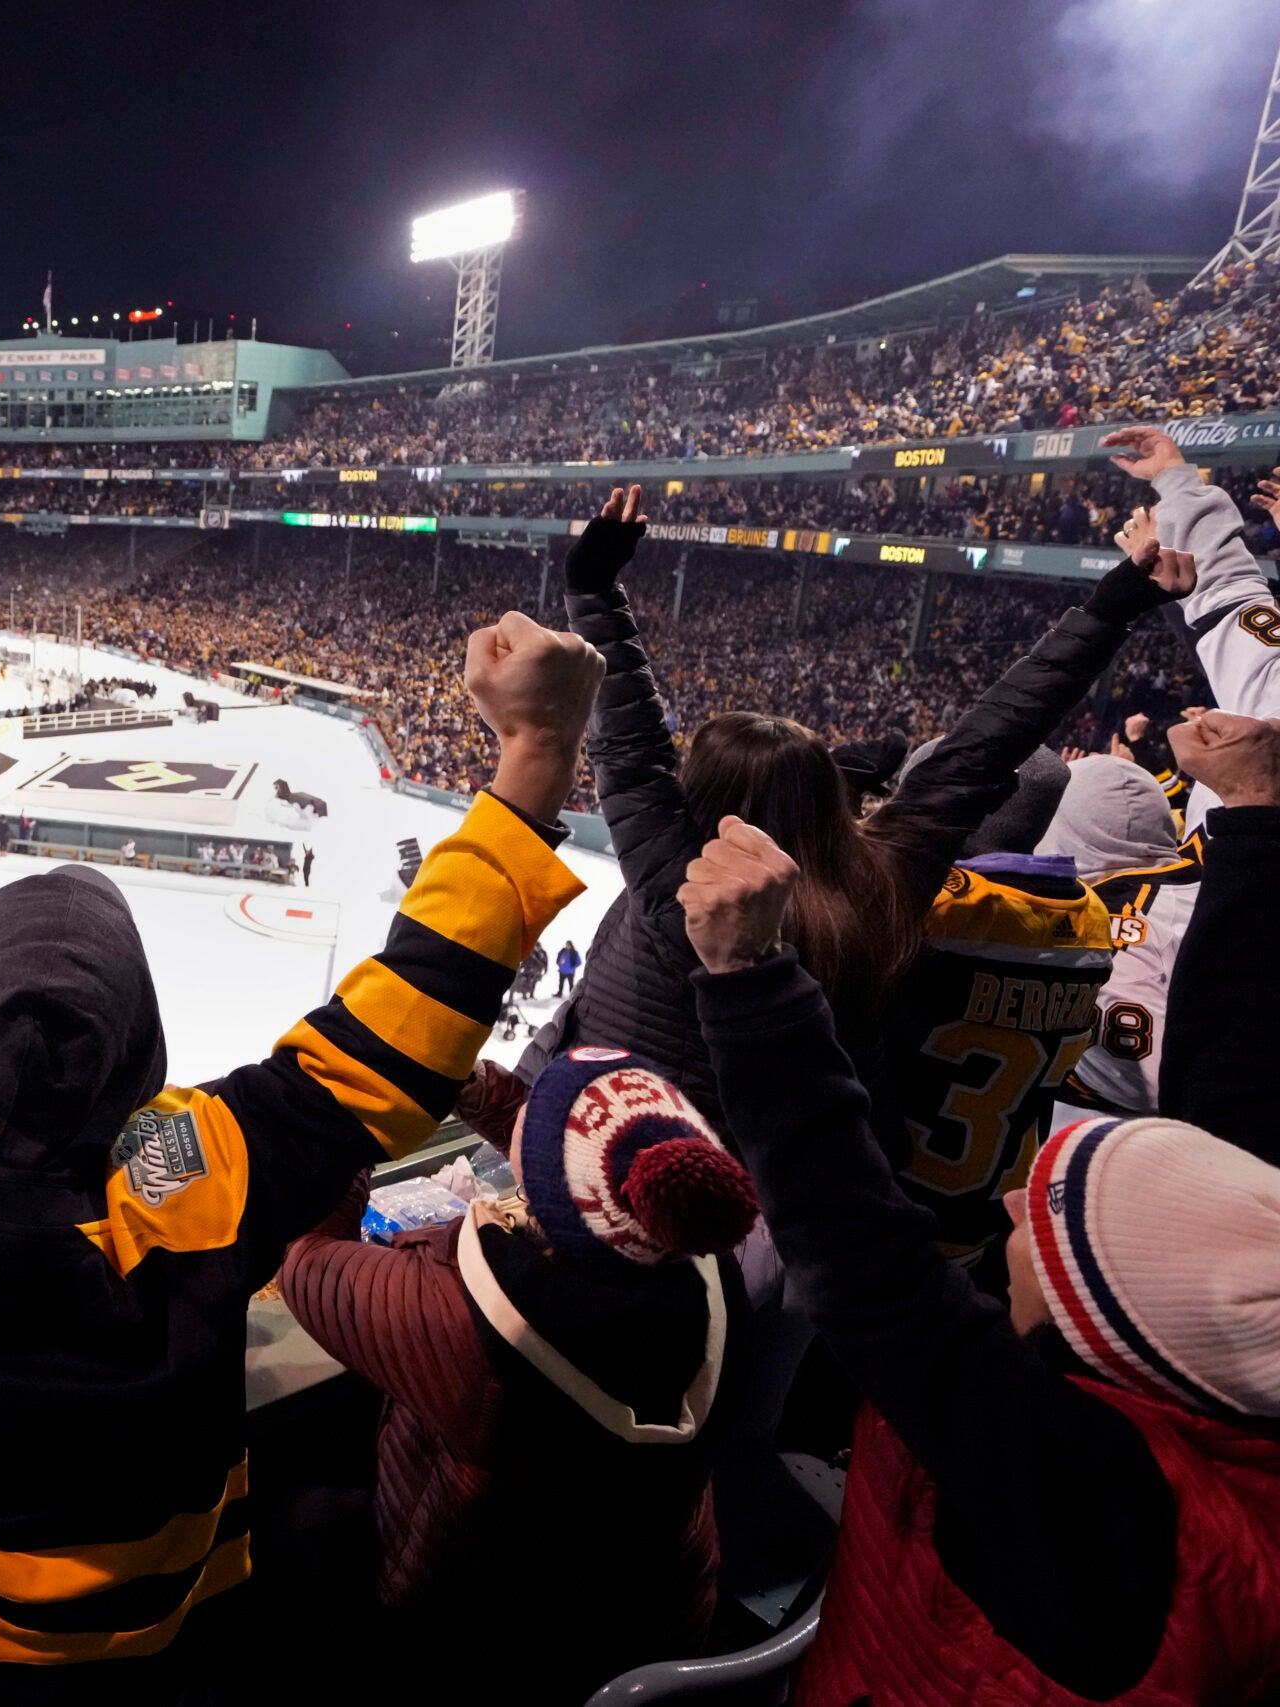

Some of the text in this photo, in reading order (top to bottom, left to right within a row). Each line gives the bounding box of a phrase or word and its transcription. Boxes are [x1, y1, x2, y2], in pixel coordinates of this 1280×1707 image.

[60, 351, 97, 362] PARK
[1164, 418, 1239, 447] Winter
[1033, 433, 1074, 457] PIT
[894, 448, 945, 467] BOSTON
[111, 469, 153, 480] PENGUINS
[339, 469, 378, 482] BOSTON
[644, 523, 710, 542] PENGUINS
[727, 528, 768, 546] BRUINS
[880, 545, 925, 563] BOSTON
[161, 1119, 182, 1174] CLASSIC
[179, 1122, 194, 1157] BOSTON
[138, 1110, 187, 1205] Winter
